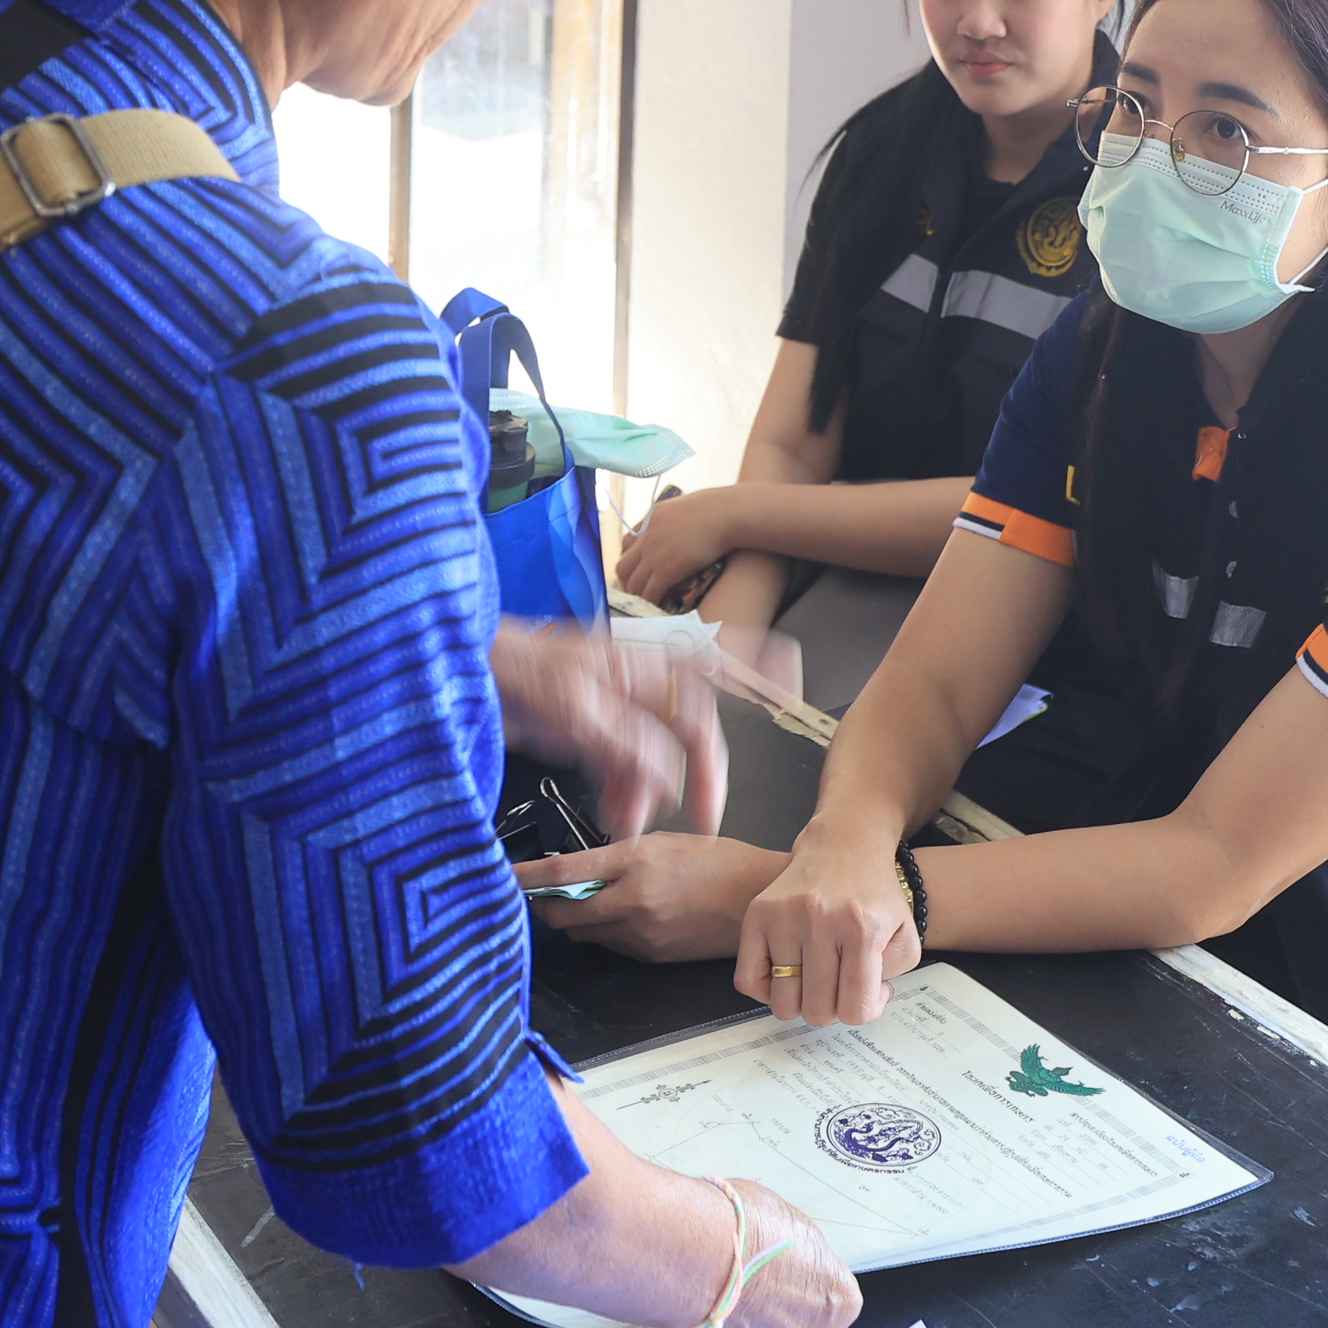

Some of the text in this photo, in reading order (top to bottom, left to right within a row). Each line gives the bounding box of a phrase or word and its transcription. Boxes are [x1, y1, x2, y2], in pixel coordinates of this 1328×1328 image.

[1219, 200, 1266, 224] MaxxLife
[961, 1070, 1035, 1123] โฉนดเพื่อการเกษตร
[1078, 1133, 1098, 1145] 2396
[1165, 1134, 1206, 1163] ฉบับผู้ถือ
